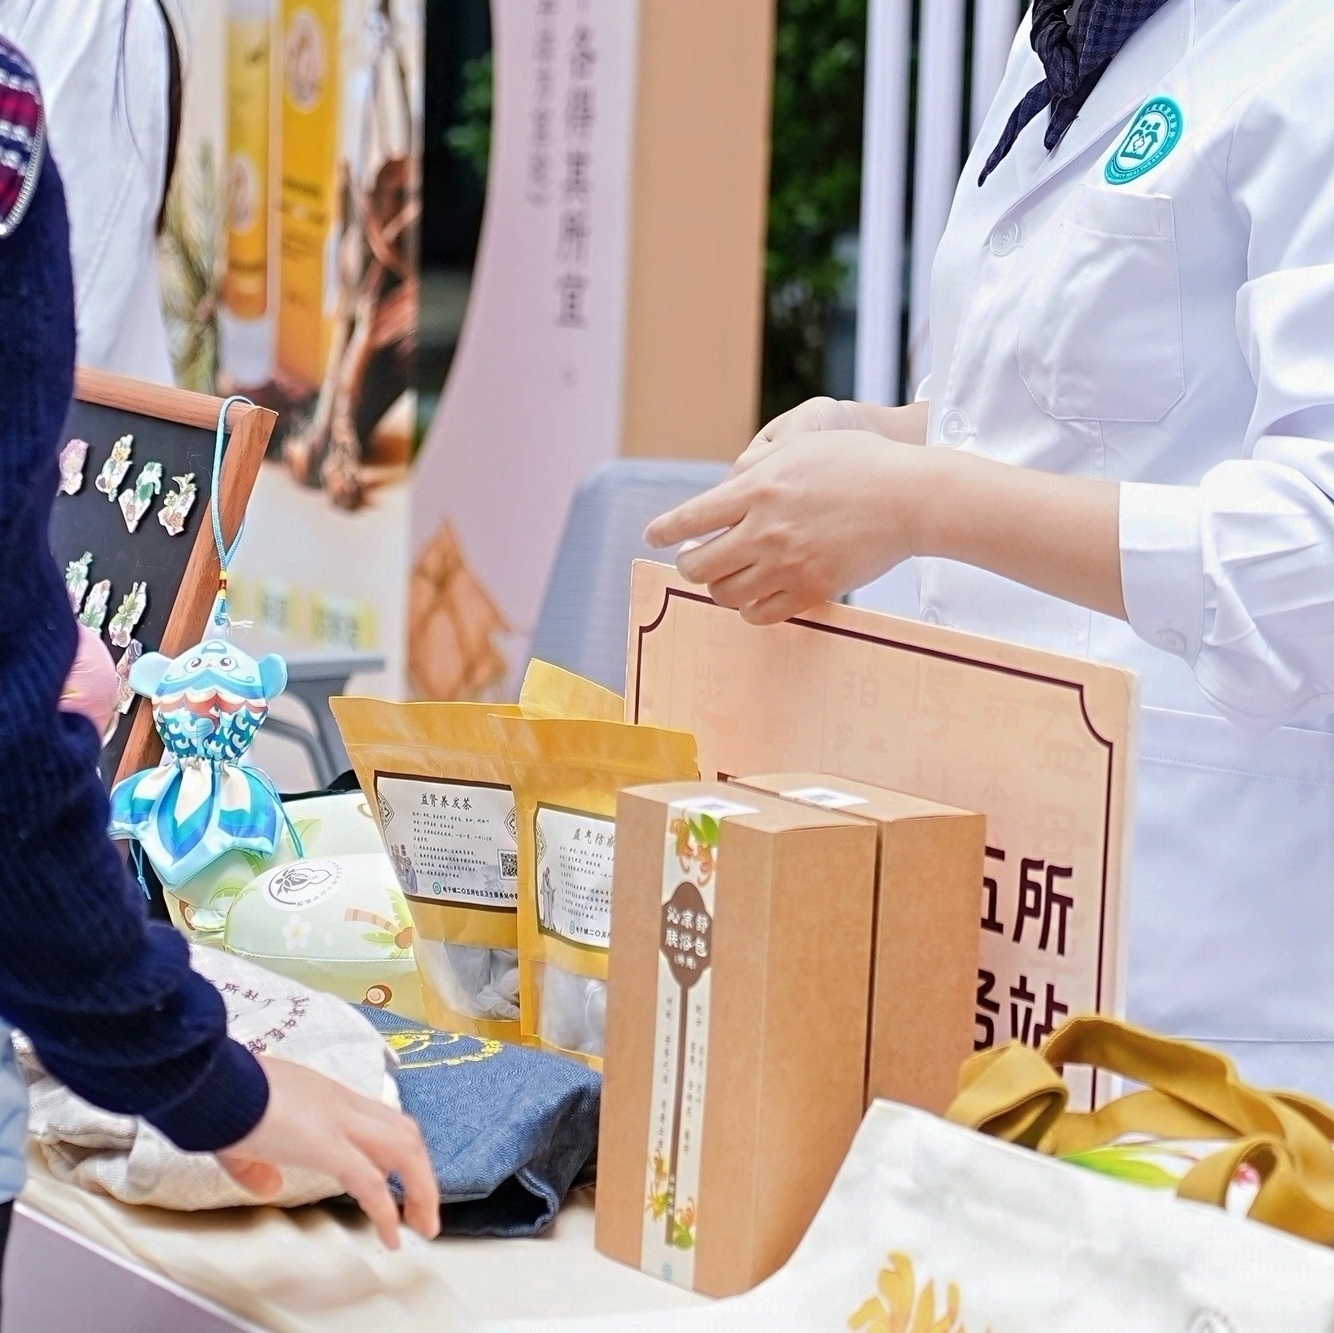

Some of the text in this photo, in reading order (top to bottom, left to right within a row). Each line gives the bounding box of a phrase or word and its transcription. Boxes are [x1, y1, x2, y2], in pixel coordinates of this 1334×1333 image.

[420, 793, 473, 811] 益肾养发茶
